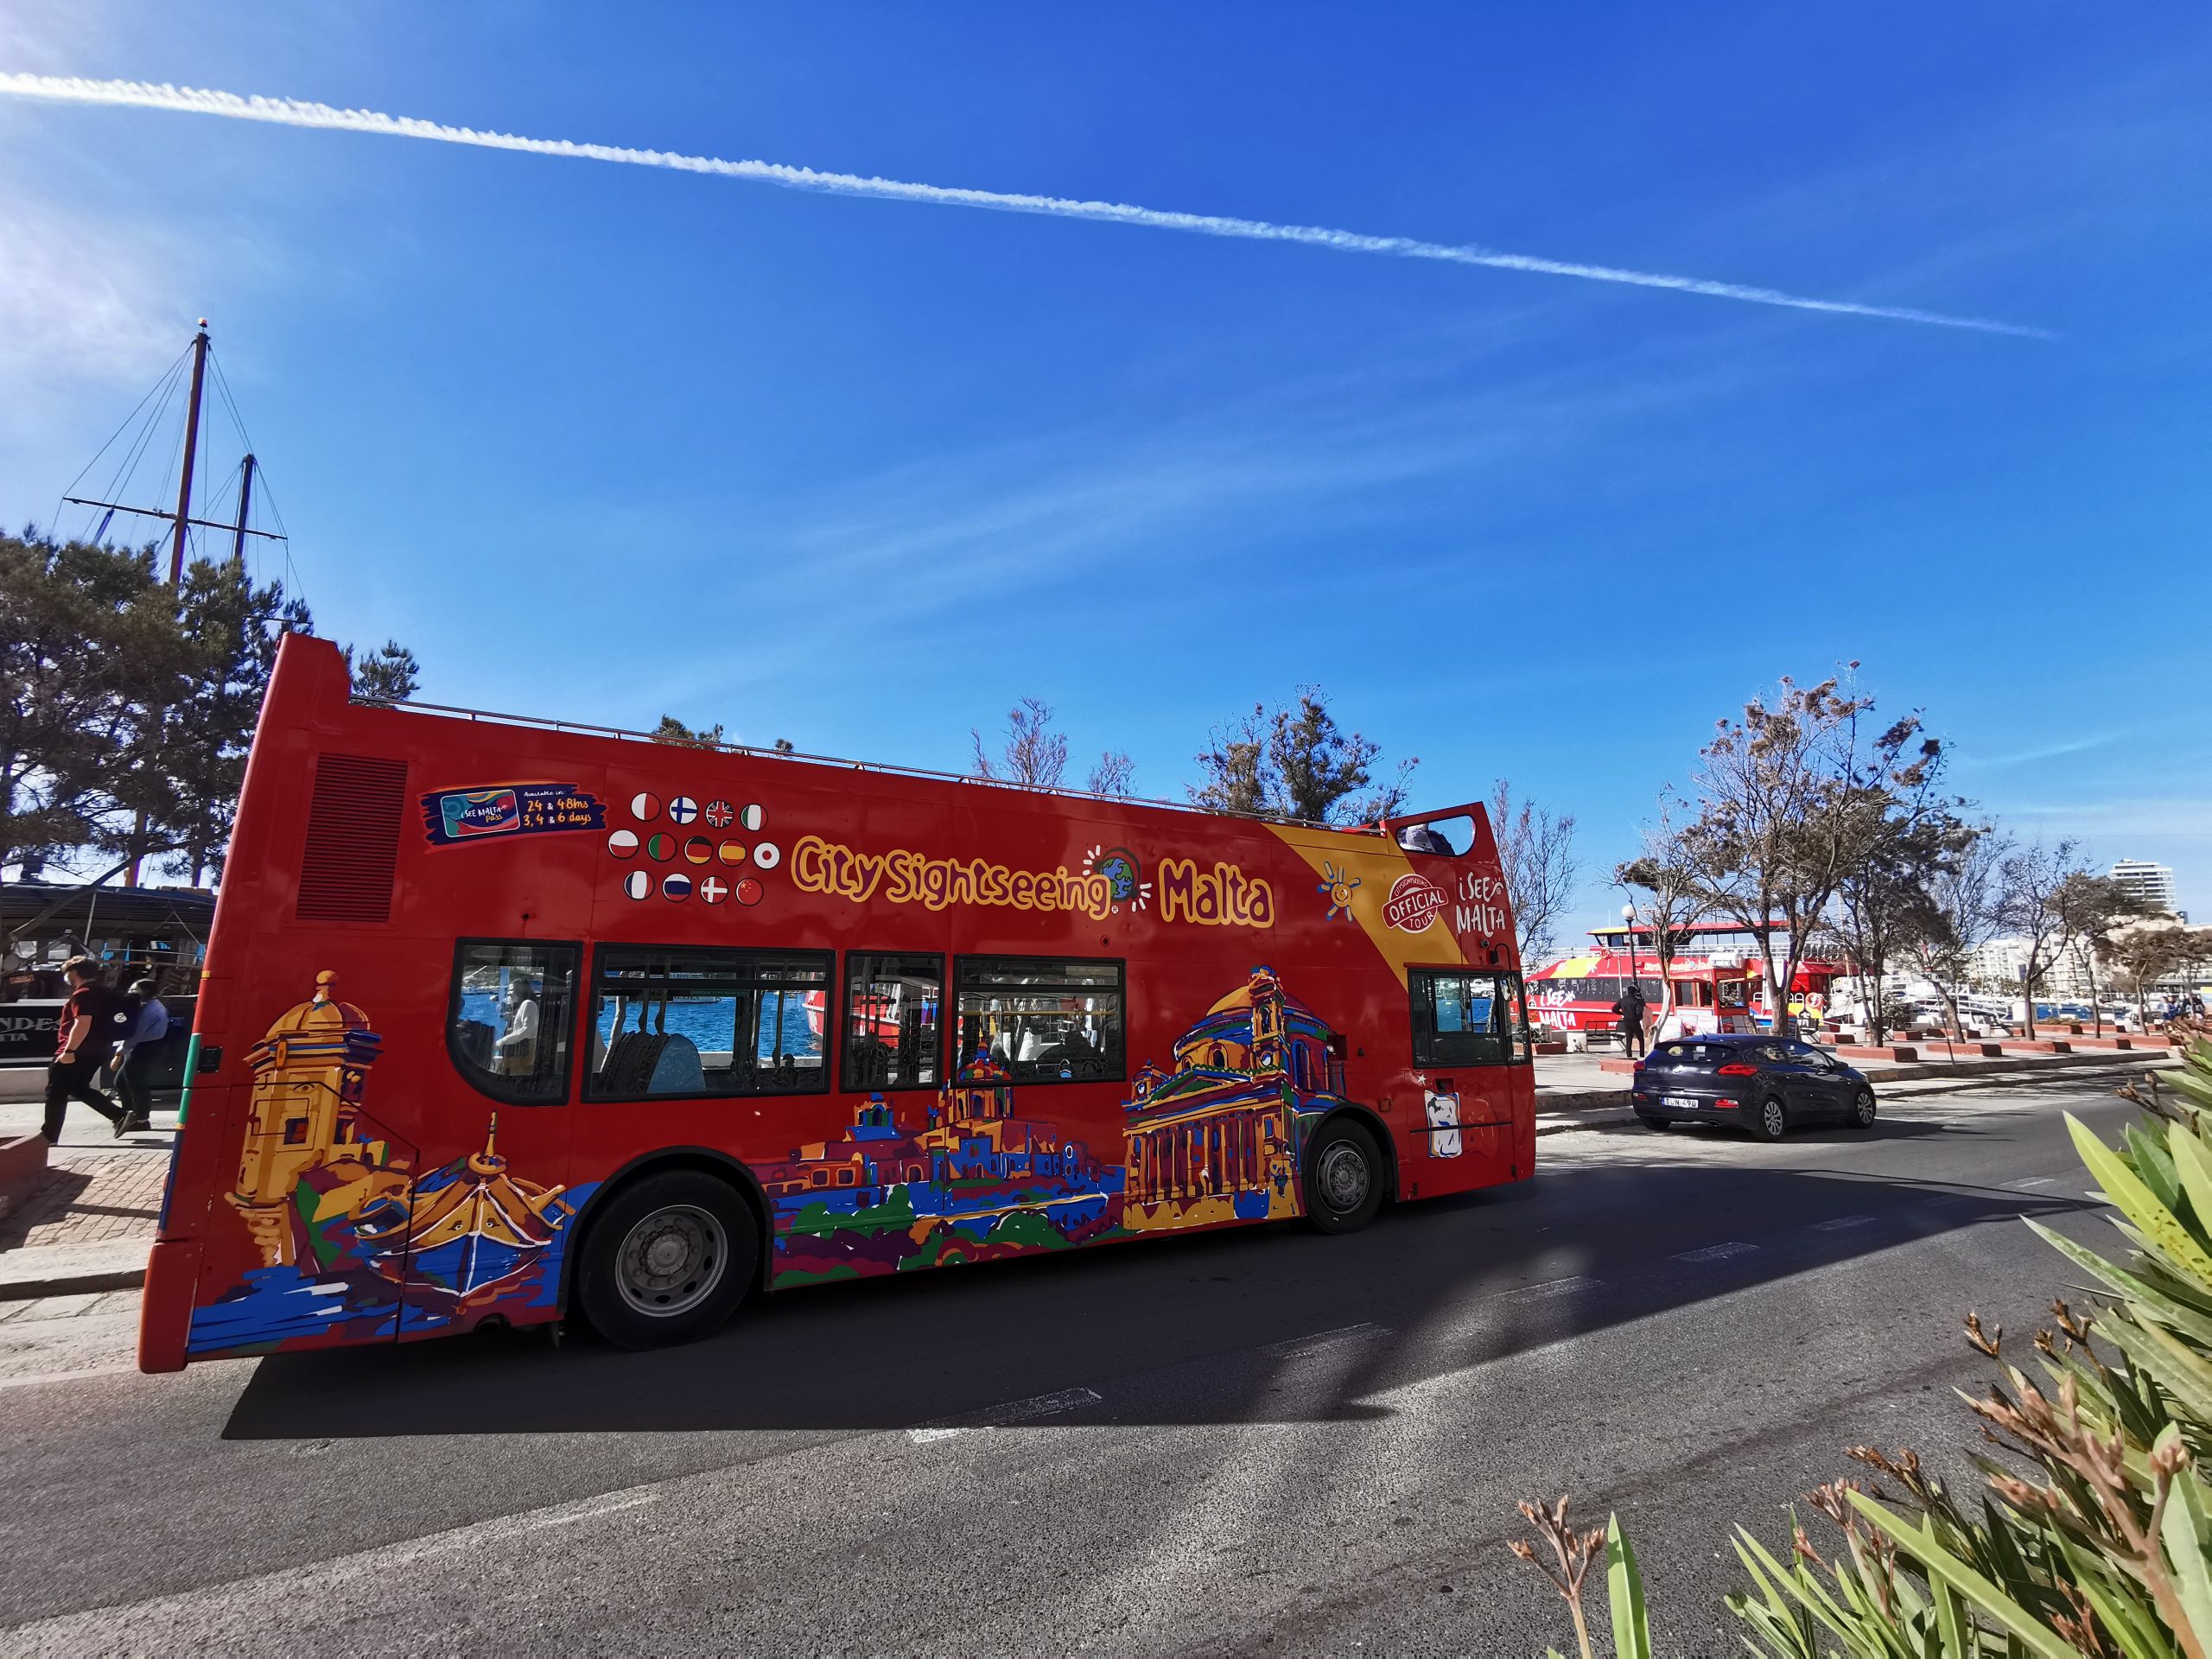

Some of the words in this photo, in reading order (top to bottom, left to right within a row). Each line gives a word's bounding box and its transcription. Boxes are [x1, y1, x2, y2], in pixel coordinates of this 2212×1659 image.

[465, 809, 476, 817] SEE
[478, 806, 501, 817] MALTA
[527, 799, 543, 811] 24
[547, 802, 554, 810] &
[486, 814, 503, 823] pass
[536, 813, 544, 825] 4
[557, 812, 565, 823] 6
[569, 811, 592, 825] days
[1159, 857, 1274, 928] Malta
[1466, 871, 1493, 903] SEE
[1389, 890, 1445, 922] OFFICIAL
[1409, 911, 1434, 929] TOUR
[1456, 904, 1506, 938] MALTA
[1547, 988, 1566, 1007] SEE
[1538, 1010, 1576, 1030] MALTA
